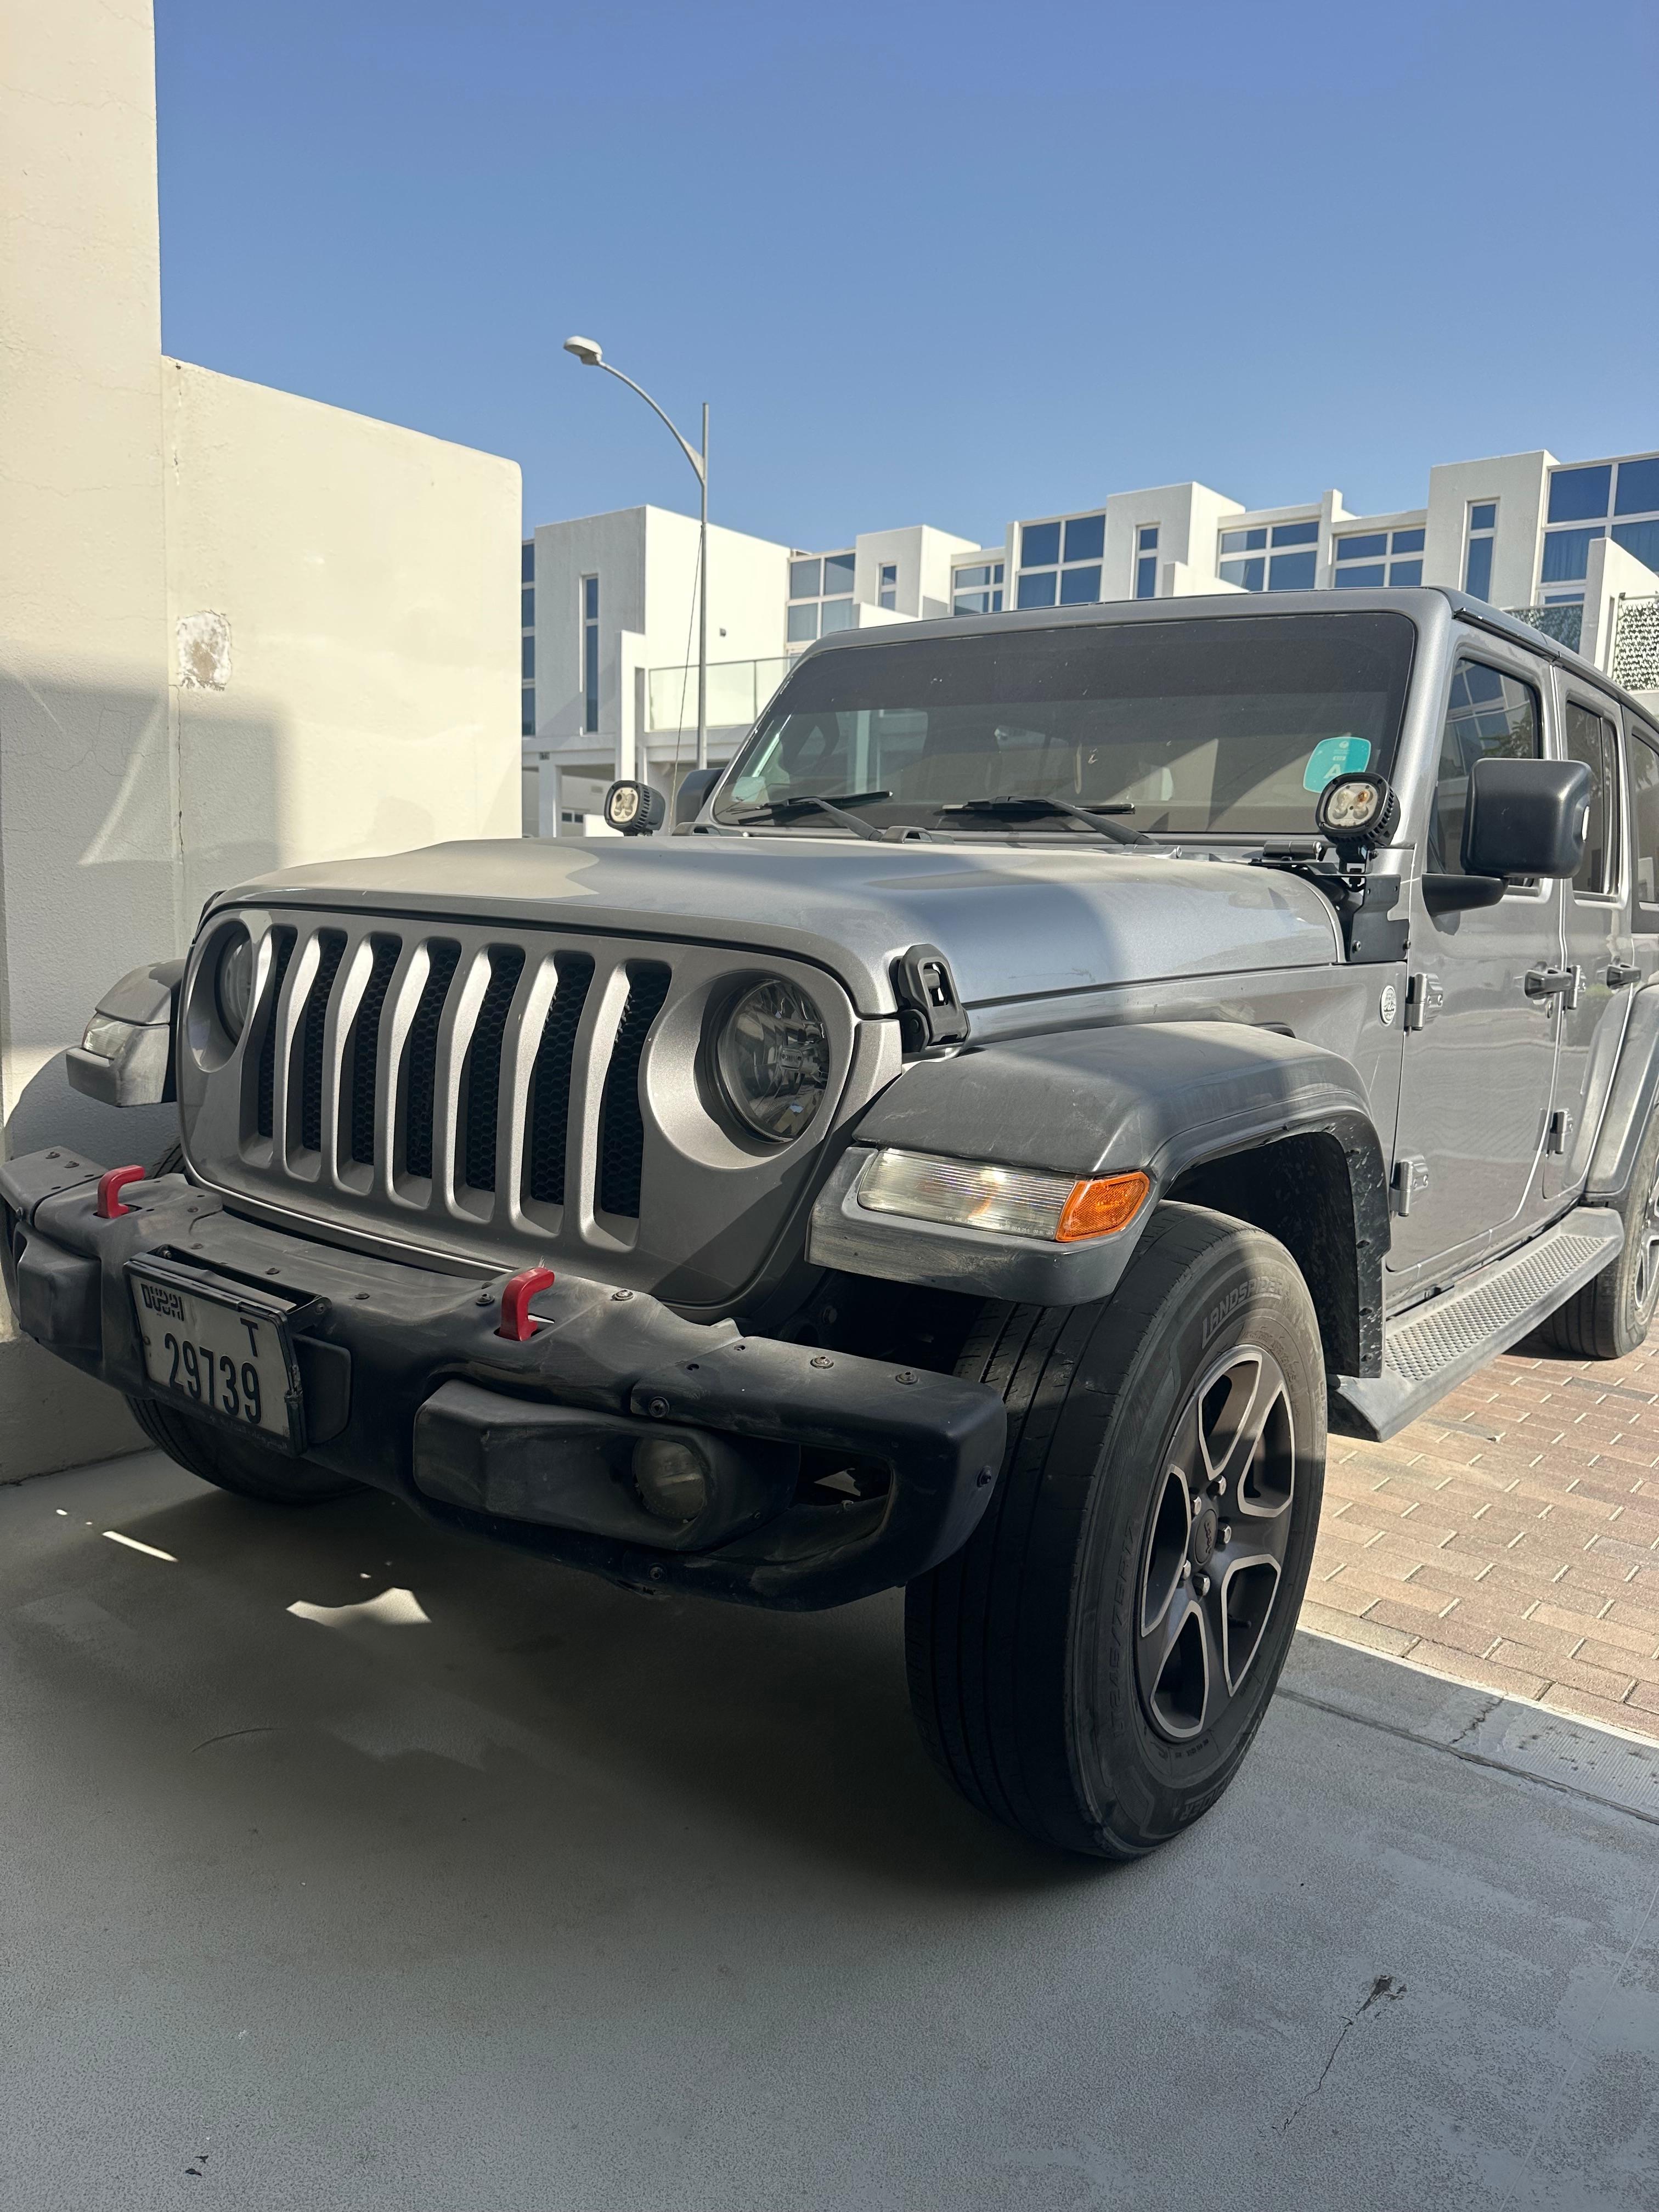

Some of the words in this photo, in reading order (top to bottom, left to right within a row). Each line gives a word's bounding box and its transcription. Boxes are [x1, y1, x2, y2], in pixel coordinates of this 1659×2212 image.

[1323, 764, 1341, 779] A
[240, 1318, 258, 1358] T
[1201, 1276, 1283, 1350] LANDSPIDER
[165, 1333, 262, 1425] 29739
